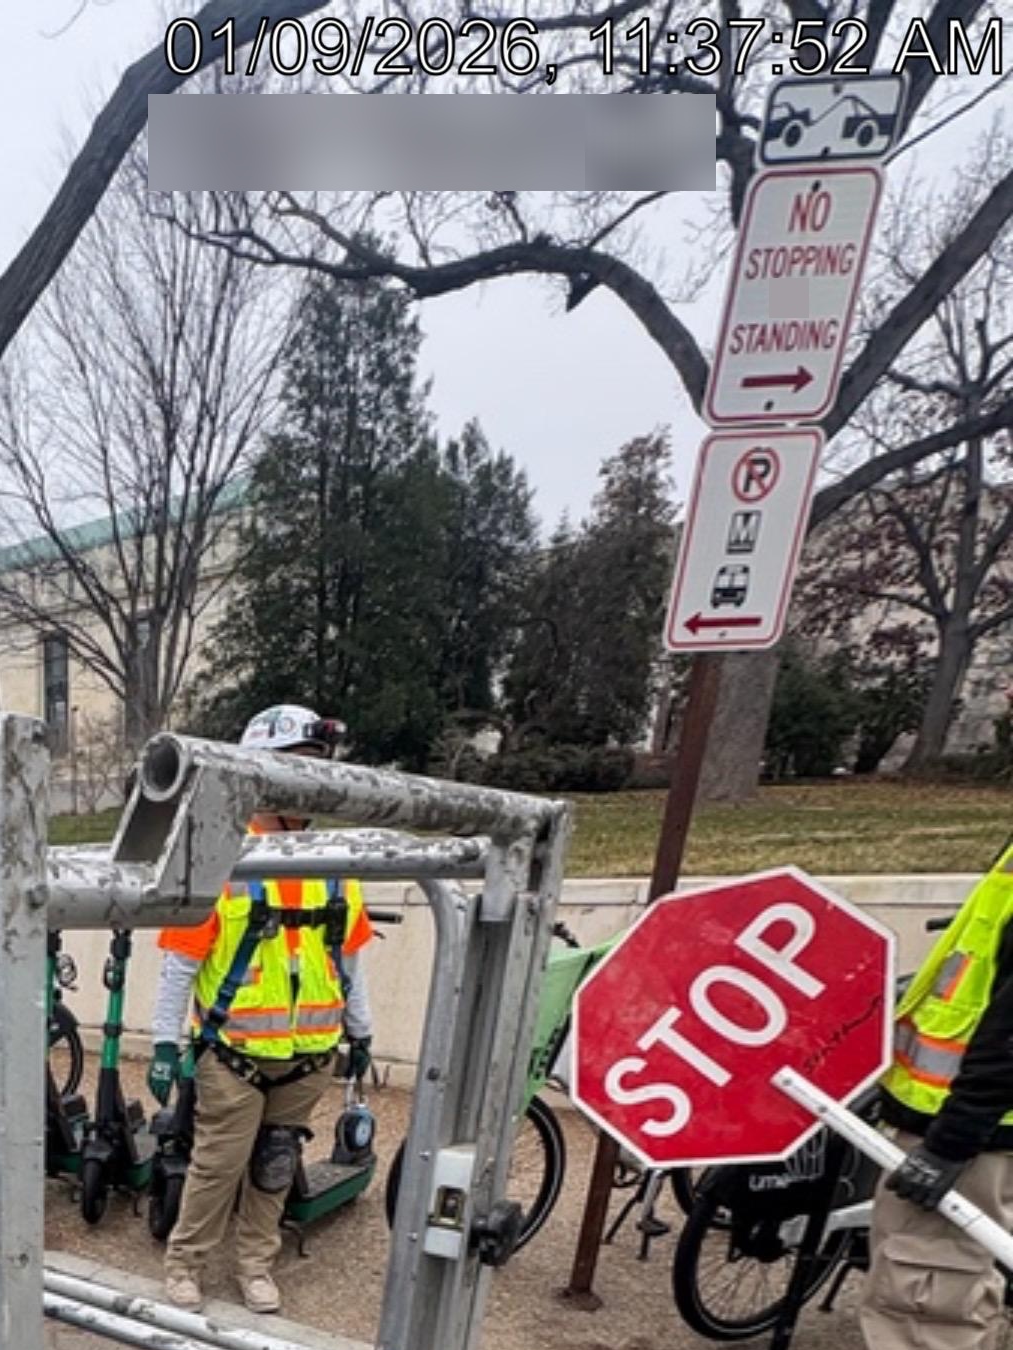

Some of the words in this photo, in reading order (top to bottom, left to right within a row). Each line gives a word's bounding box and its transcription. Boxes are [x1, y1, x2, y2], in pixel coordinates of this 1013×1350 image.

[788, 191, 832, 233] NO
[744, 242, 858, 280] STOPPING
[729, 318, 840, 355] STANDING
[604, 902, 826, 1137] STOP
